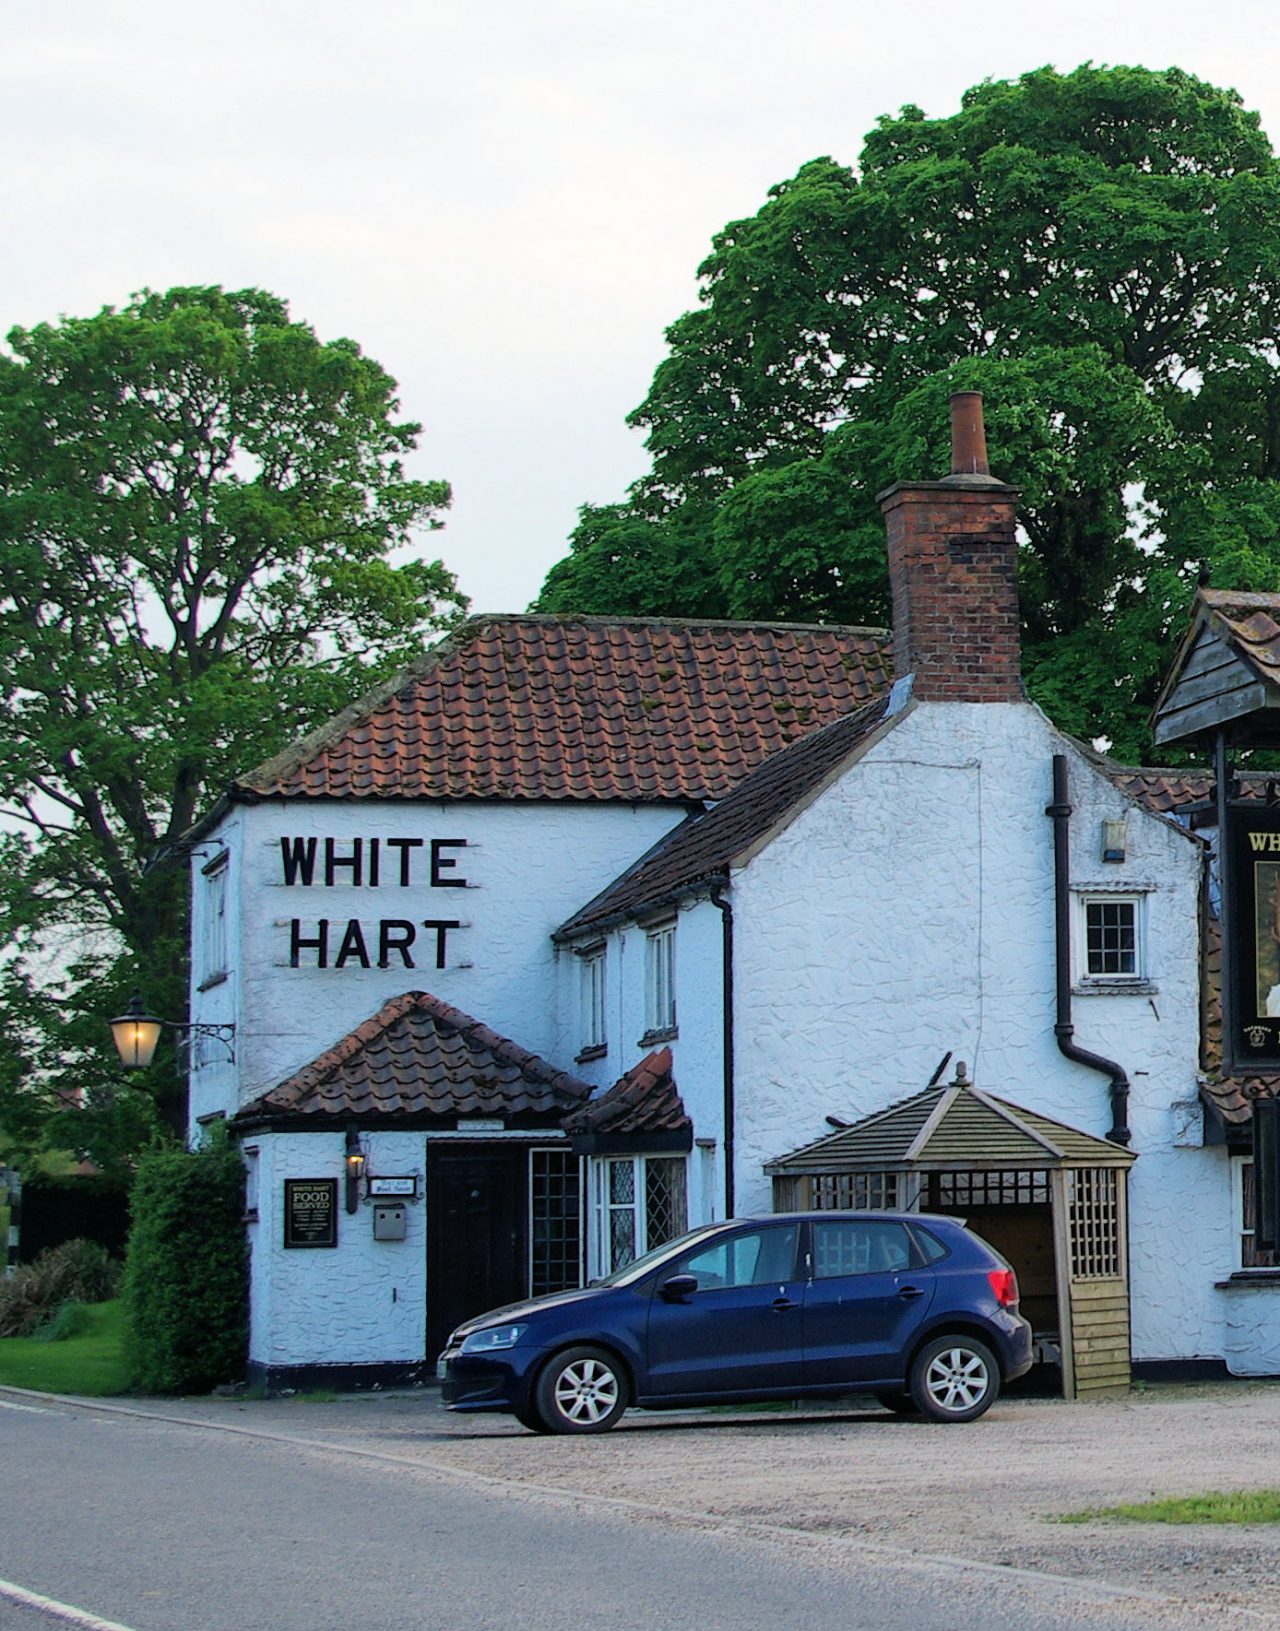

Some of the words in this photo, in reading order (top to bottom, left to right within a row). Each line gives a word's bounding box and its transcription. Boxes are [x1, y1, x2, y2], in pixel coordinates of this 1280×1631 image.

[281, 837, 467, 887] WHITE
[291, 919, 460, 968] HART
[293, 1192, 330, 1202] FOOD
